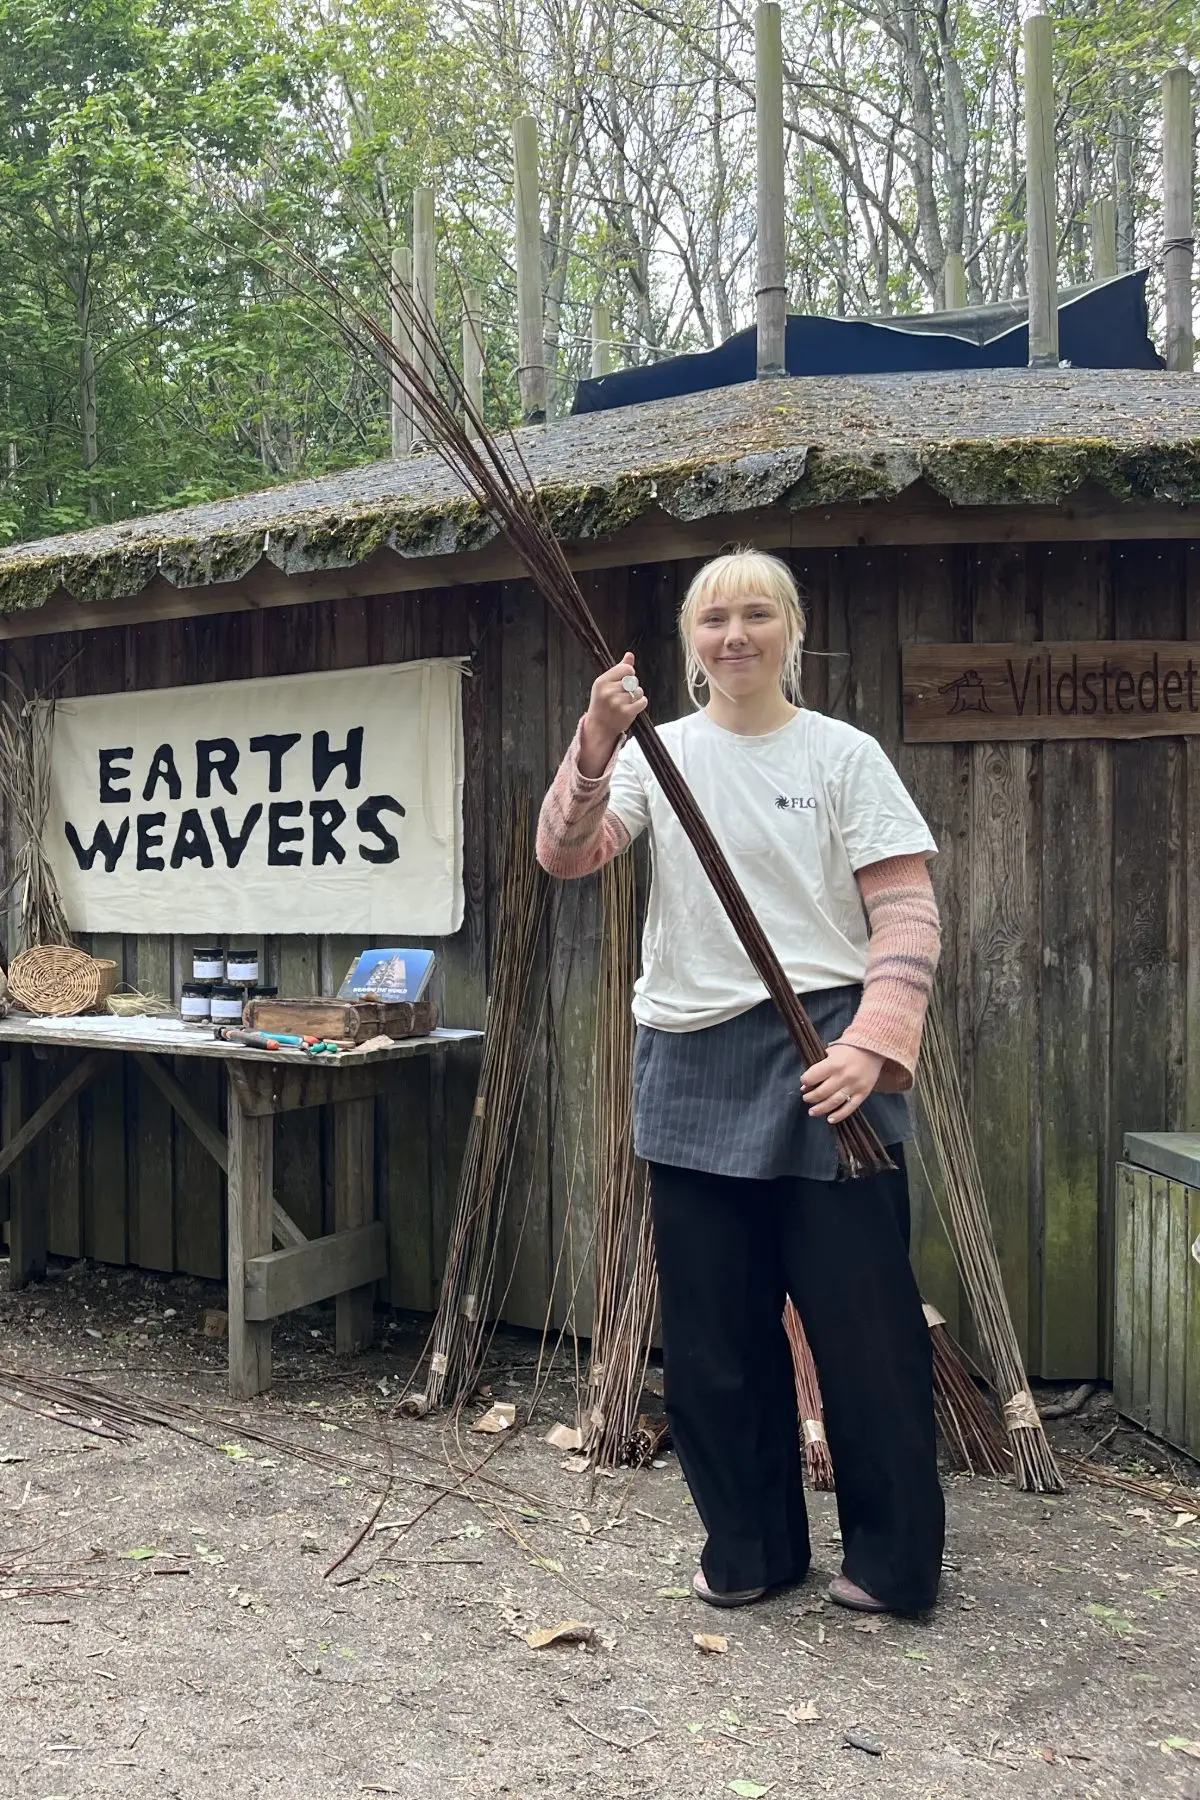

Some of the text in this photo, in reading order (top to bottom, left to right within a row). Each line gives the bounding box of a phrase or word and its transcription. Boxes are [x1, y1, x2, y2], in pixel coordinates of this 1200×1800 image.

[1007, 652, 1198, 716] Vildstedet
[99, 726, 364, 804] EARTH
[65, 795, 406, 873] WEAVERS
